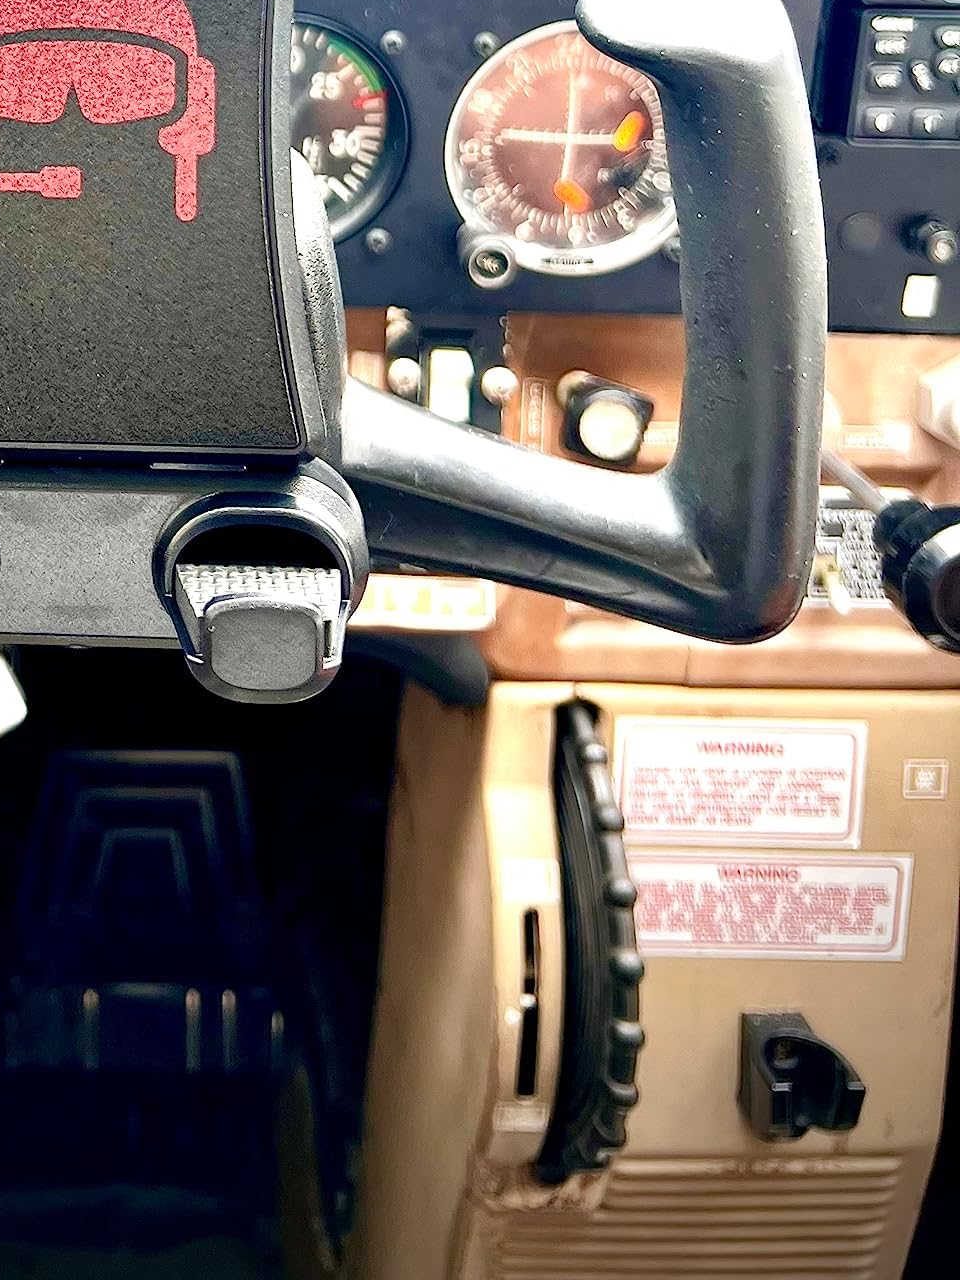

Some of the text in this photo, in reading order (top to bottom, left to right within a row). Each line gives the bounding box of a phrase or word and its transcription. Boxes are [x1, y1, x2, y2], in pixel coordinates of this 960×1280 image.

[309, 71, 343, 100] 25
[329, 128, 361, 158] 30
[697, 740, 784, 758] WARNING
[717, 865, 800, 883] WARNING
